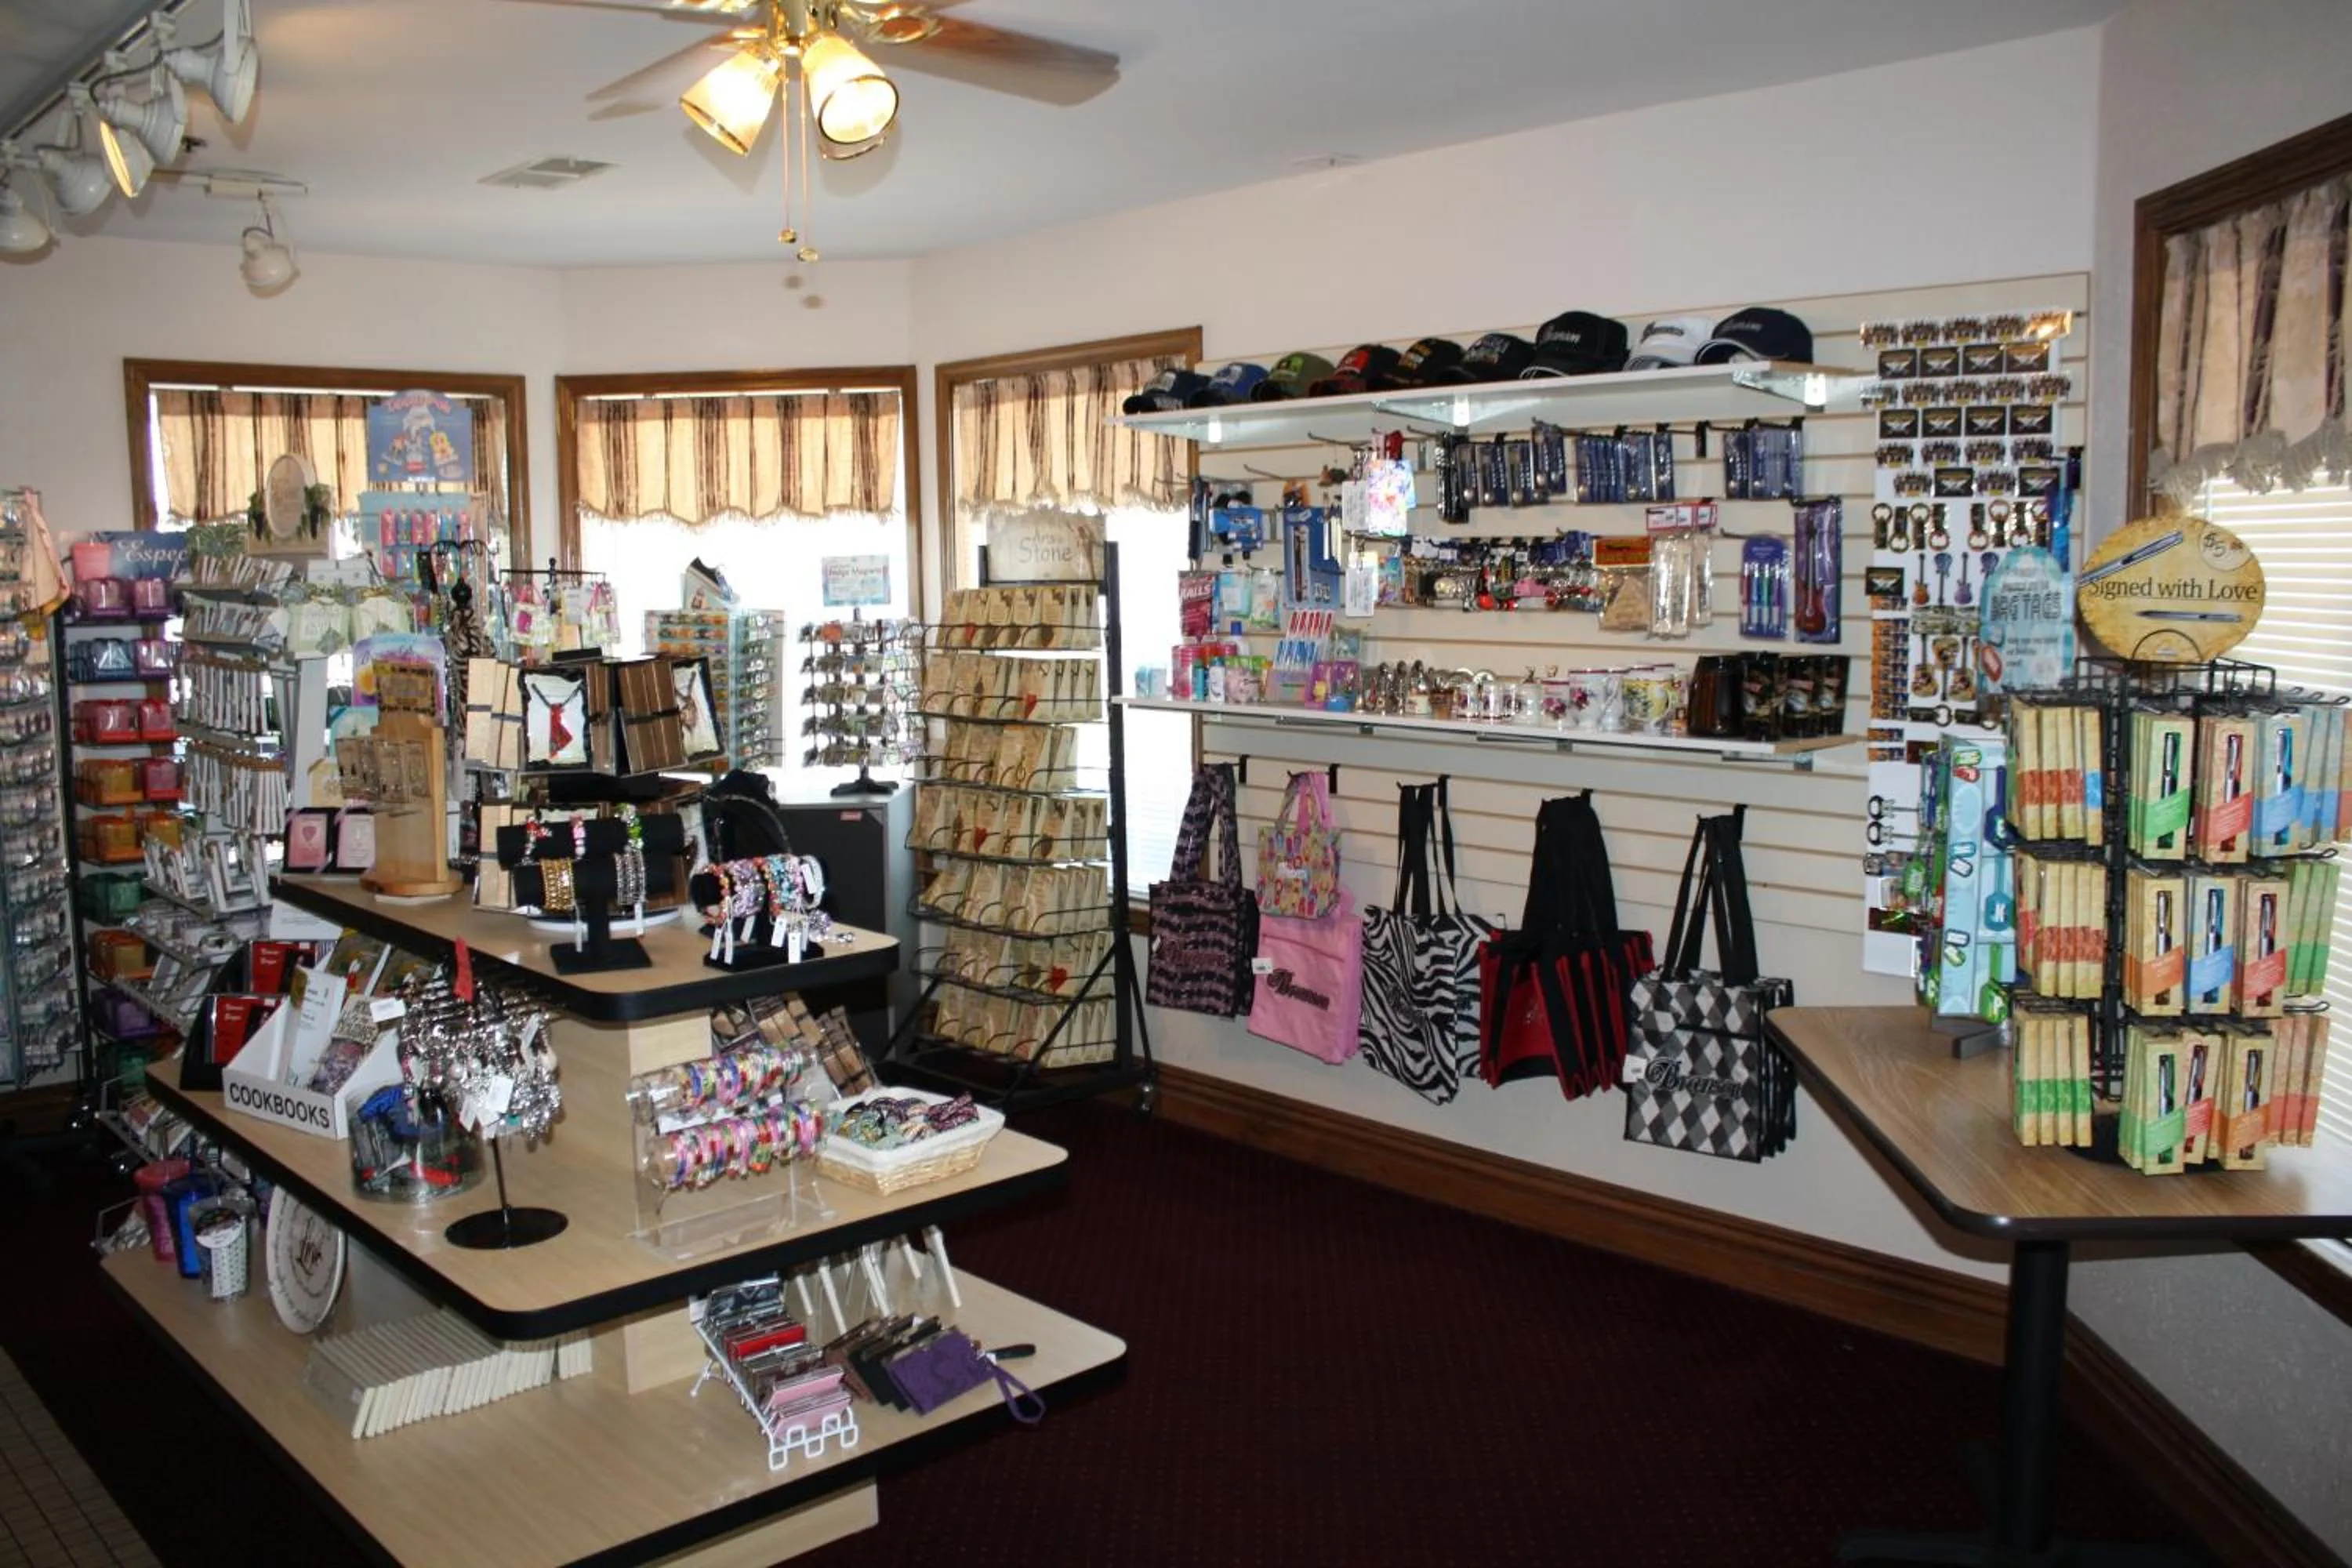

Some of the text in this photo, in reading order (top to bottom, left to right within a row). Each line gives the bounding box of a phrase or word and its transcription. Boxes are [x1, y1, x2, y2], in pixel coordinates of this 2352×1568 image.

[2088, 576, 2258, 601] Signed with Love
[229, 1083, 330, 1129] COOKBOOKS
